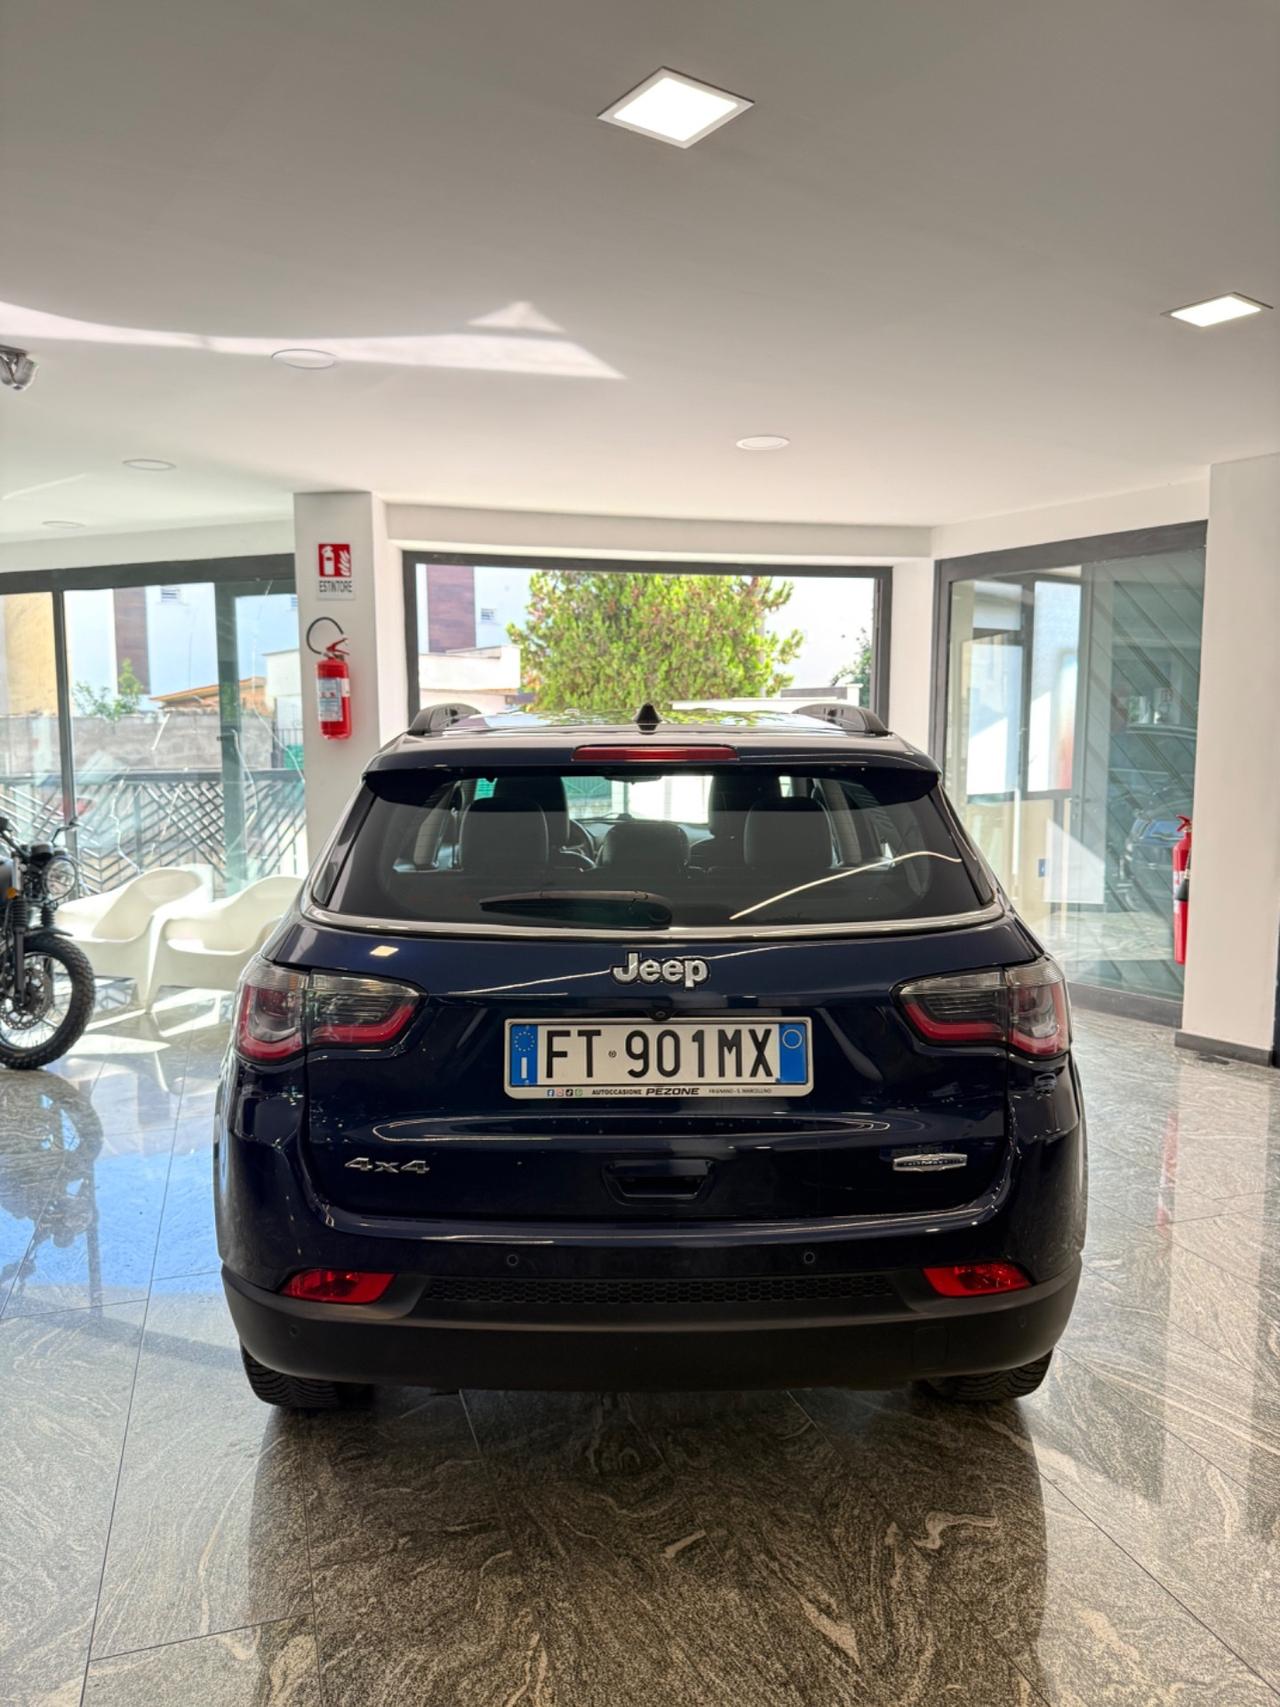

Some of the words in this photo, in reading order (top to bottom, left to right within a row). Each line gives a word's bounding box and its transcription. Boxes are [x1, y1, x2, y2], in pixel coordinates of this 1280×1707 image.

[319, 580, 353, 593] ESTINTORE
[612, 952, 709, 988] Jeep
[545, 1029, 602, 1079] FT
[624, 1029, 774, 1079] 901MX
[591, 1088, 642, 1096] AUTOCCASIONE
[645, 1087, 700, 1096] PEZONE
[344, 1156, 431, 1174] 4x4
